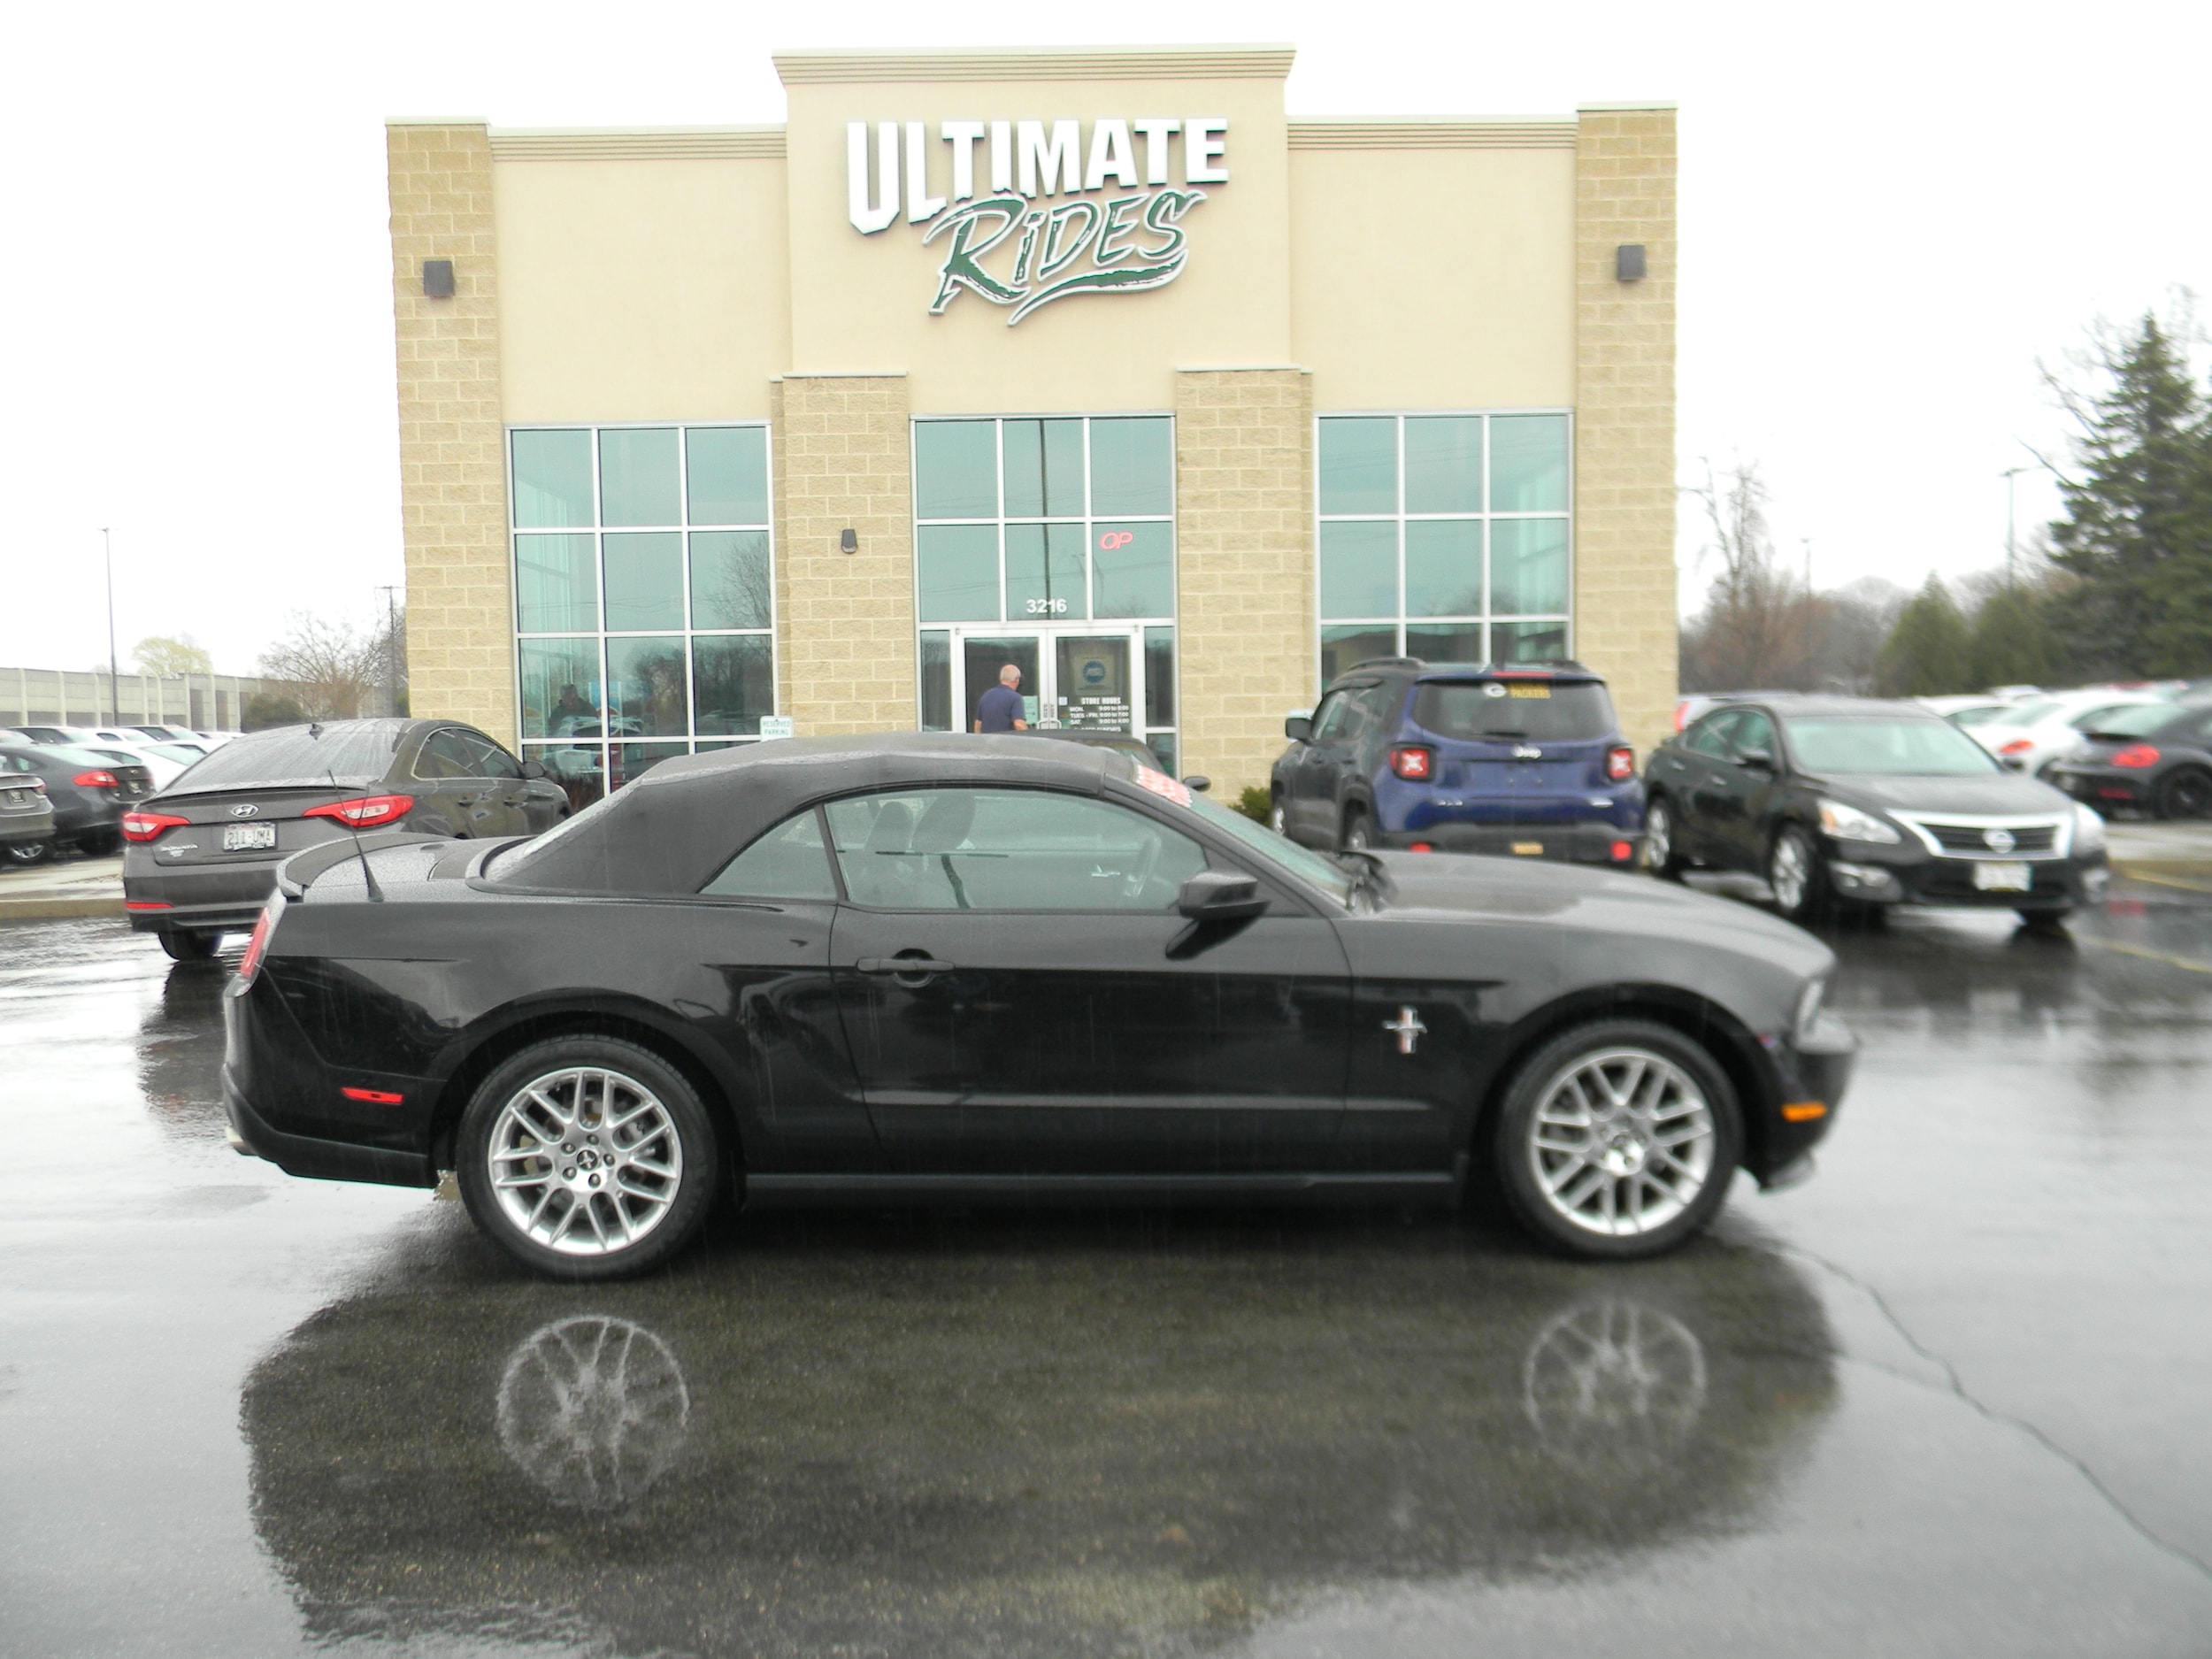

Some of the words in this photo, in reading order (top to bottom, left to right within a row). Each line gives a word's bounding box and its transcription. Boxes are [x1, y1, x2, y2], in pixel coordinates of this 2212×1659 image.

[847, 117, 1230, 236] ULTIMATE
[1100, 531, 1133, 550] OP
[1026, 598, 1067, 614] 3216
[1081, 696, 1100, 705] STORE
[1102, 696, 1121, 705] HOURS
[1511, 745, 1541, 759] Jeep
